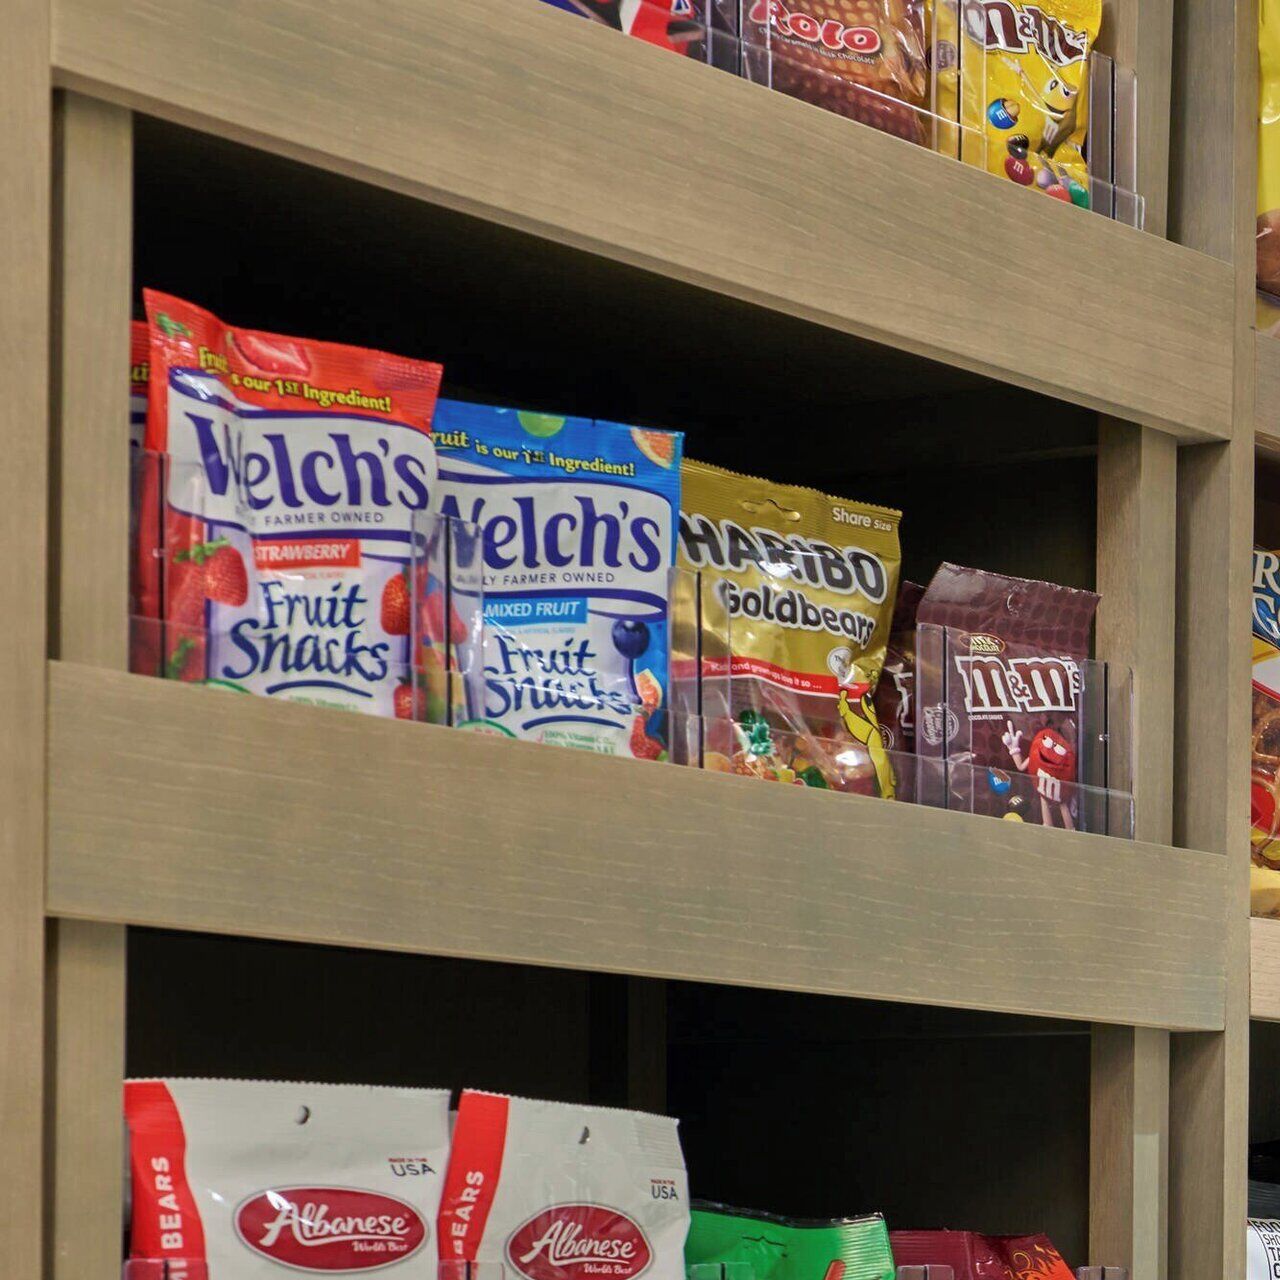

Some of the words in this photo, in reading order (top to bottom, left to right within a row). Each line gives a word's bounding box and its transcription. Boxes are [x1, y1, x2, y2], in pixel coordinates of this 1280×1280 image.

[242, 376, 270, 393] our
[303, 382, 391, 413] Ingredient!
[185, 412, 430, 510] Welch's
[476, 439, 488, 455] is
[493, 446, 518, 460] our
[550, 453, 636, 476] Ingredient!
[265, 514, 325, 526] FARMER
[330, 511, 384, 524] OWNED
[442, 495, 661, 572] Welch's
[832, 507, 871, 527] Share
[874, 519, 891, 531] Size
[255, 544, 350, 561] STRAWBERRY
[679, 511, 888, 603] HARIBO
[504, 574, 557, 584] FARMER
[562, 573, 615, 583] OWNED
[259, 581, 368, 630] Fruit
[483, 604, 531, 618] MIXED
[536, 602, 579, 616] FRUIT
[718, 579, 876, 648] Goldbears
[223, 618, 390, 681] Snacks
[494, 635, 597, 675] Fruit
[484, 667, 634, 718] Snacks
[391, 1163, 436, 1176] USA
[151, 1156, 184, 1249] BEARS
[652, 1184, 678, 1200] USA
[260, 1201, 409, 1247] Albanese
[520, 1220, 636, 1263] Albanese
